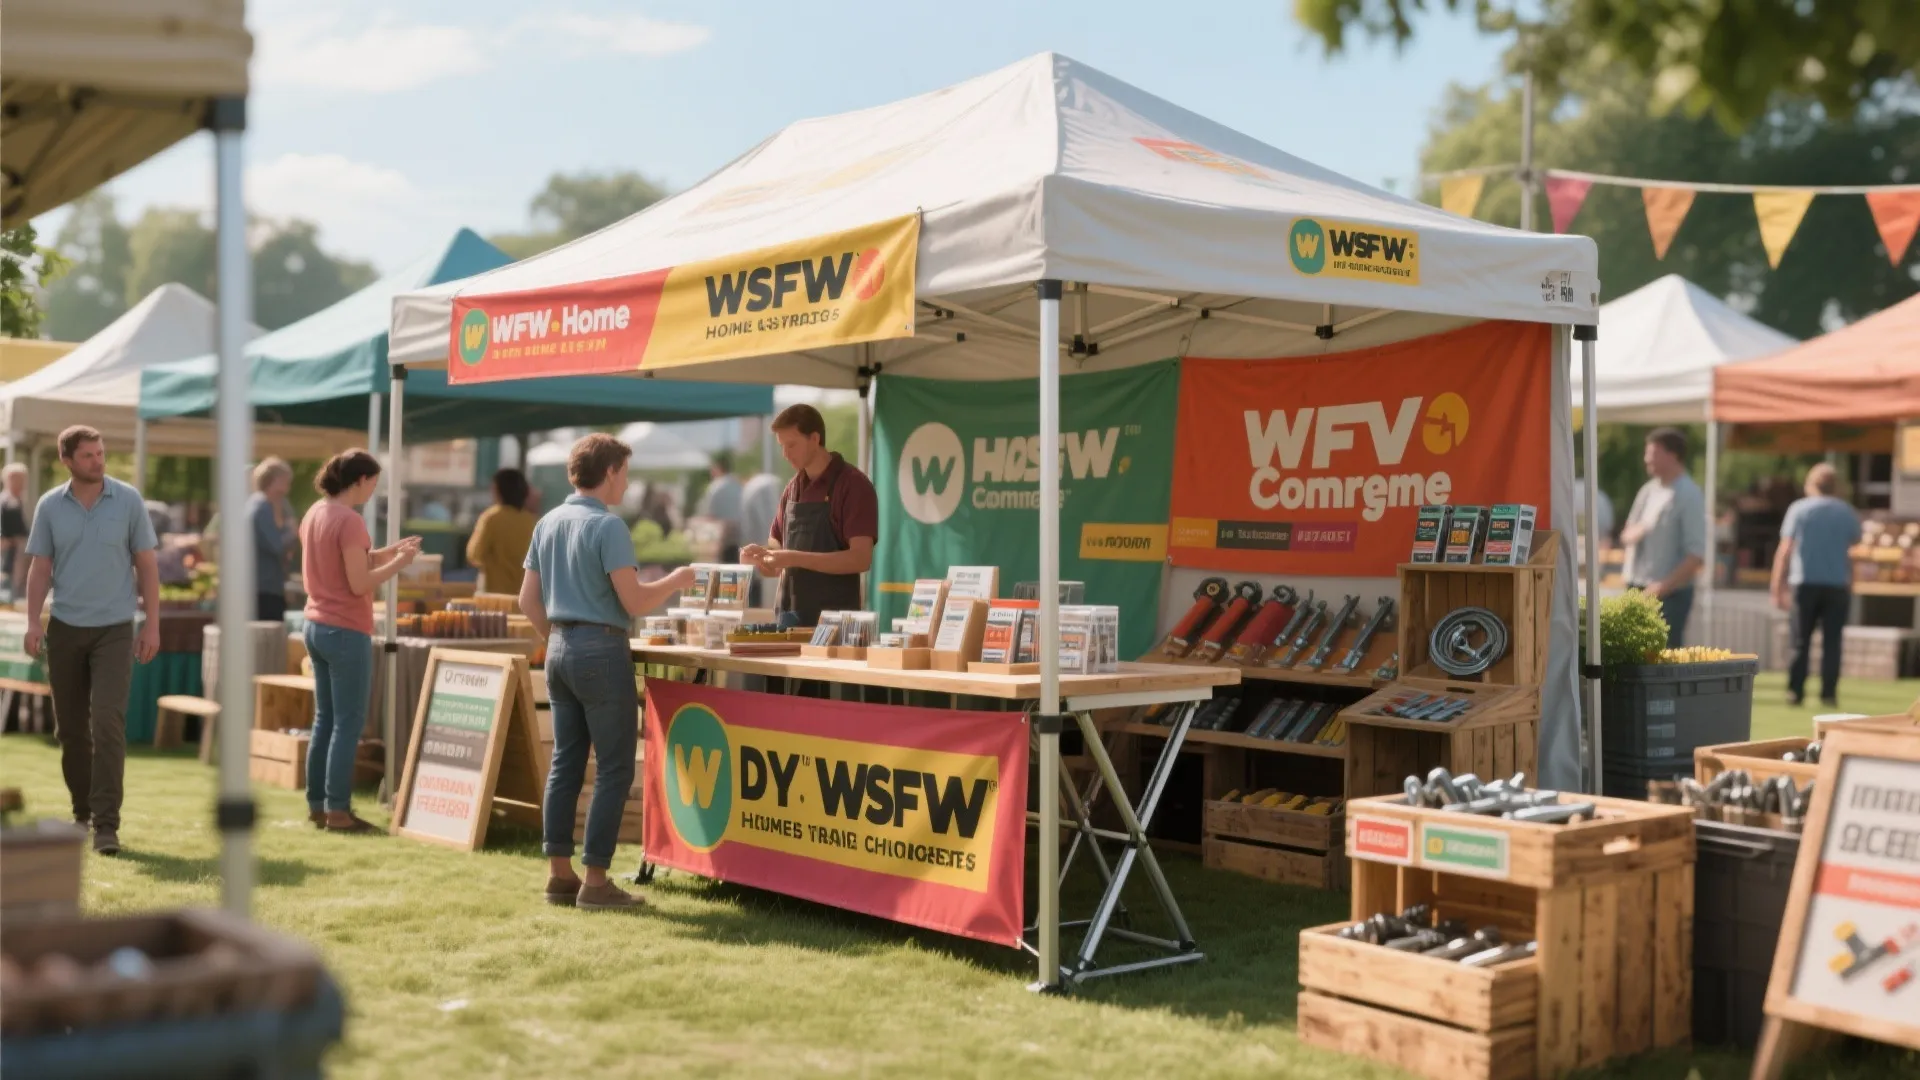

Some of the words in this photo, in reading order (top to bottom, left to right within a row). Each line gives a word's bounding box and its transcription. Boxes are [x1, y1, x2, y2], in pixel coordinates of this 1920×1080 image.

[705, 251, 853, 318] WSFW
[1243, 396, 1424, 469] WFV
[911, 455, 956, 495] W
[674, 743, 722, 809] W
[815, 757, 988, 839] WSFW
